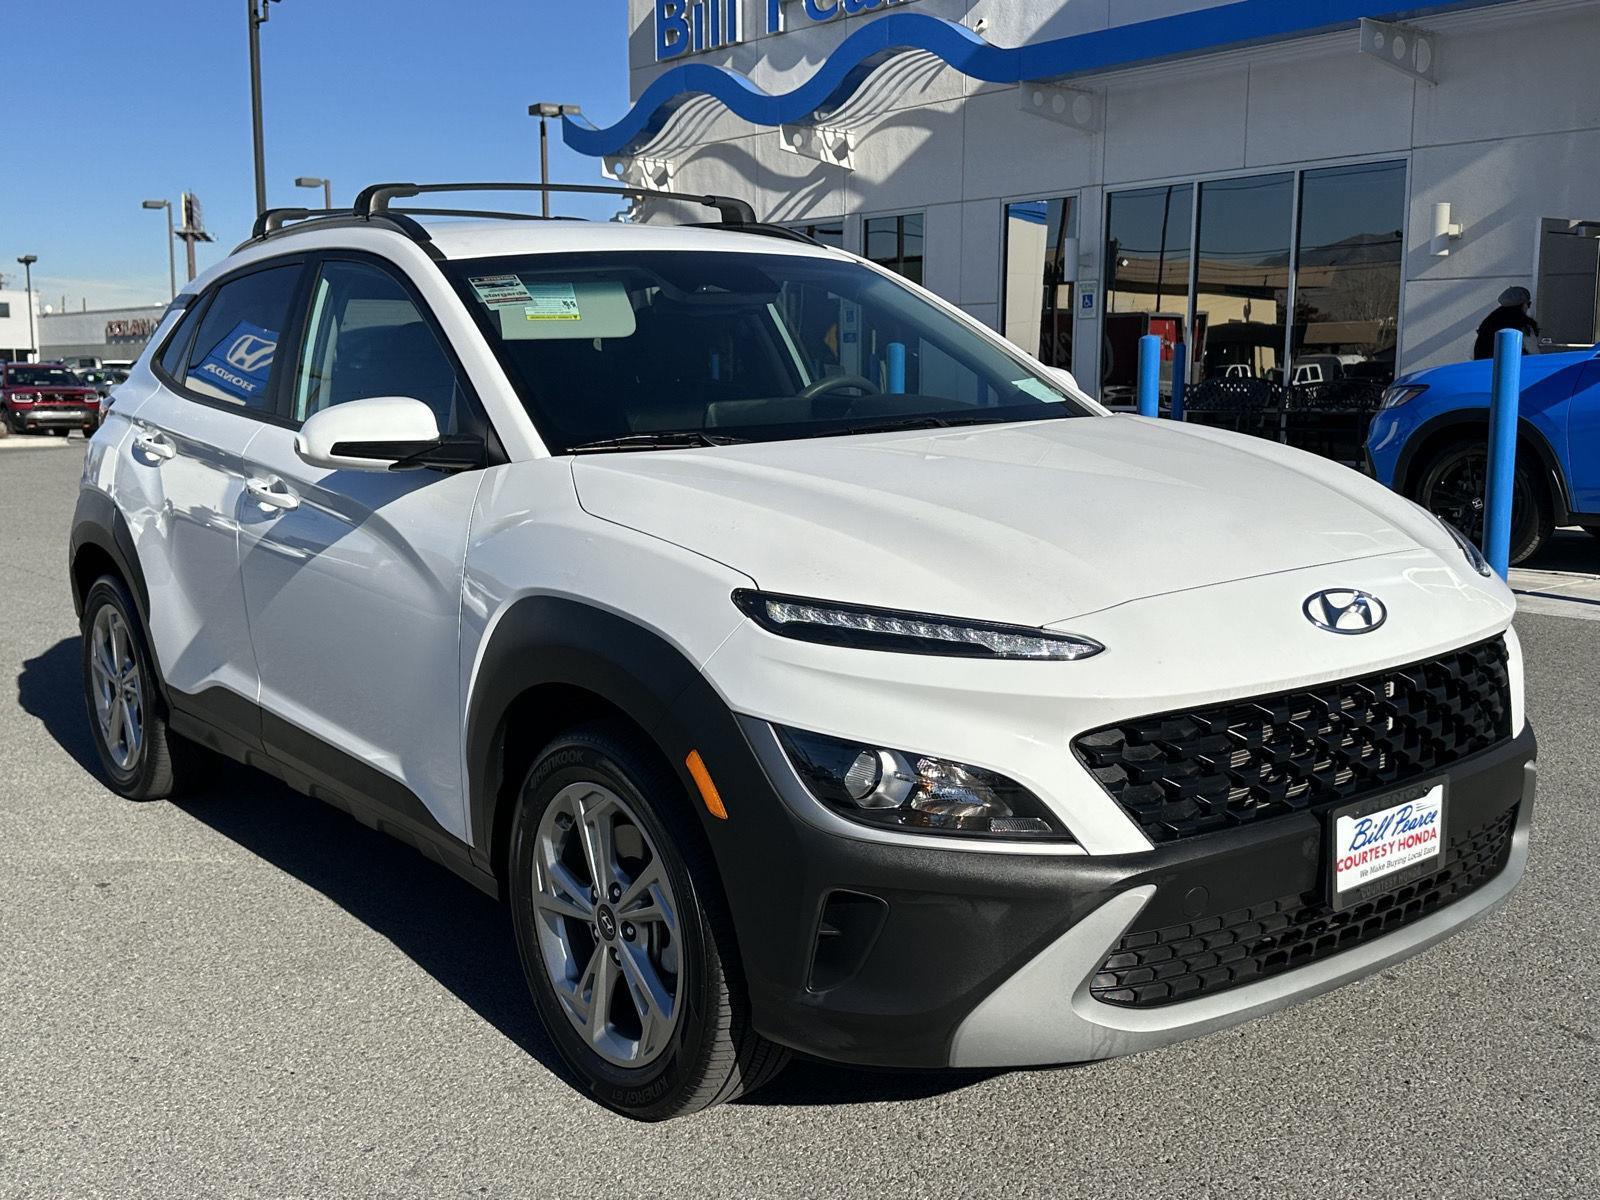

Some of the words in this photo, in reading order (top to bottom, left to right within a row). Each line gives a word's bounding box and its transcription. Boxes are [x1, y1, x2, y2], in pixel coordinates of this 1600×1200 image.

[654, 0, 743, 62] Bill
[1336, 840, 1396, 873] COURTESY
[1398, 827, 1437, 851] HONDA
[1348, 815, 1396, 852] Bill
[1391, 804, 1438, 837] Pearce
[1360, 868, 1369, 878] We
[1370, 861, 1386, 875] Make
[1387, 855, 1407, 869] Buying
[1408, 848, 1423, 861] Local
